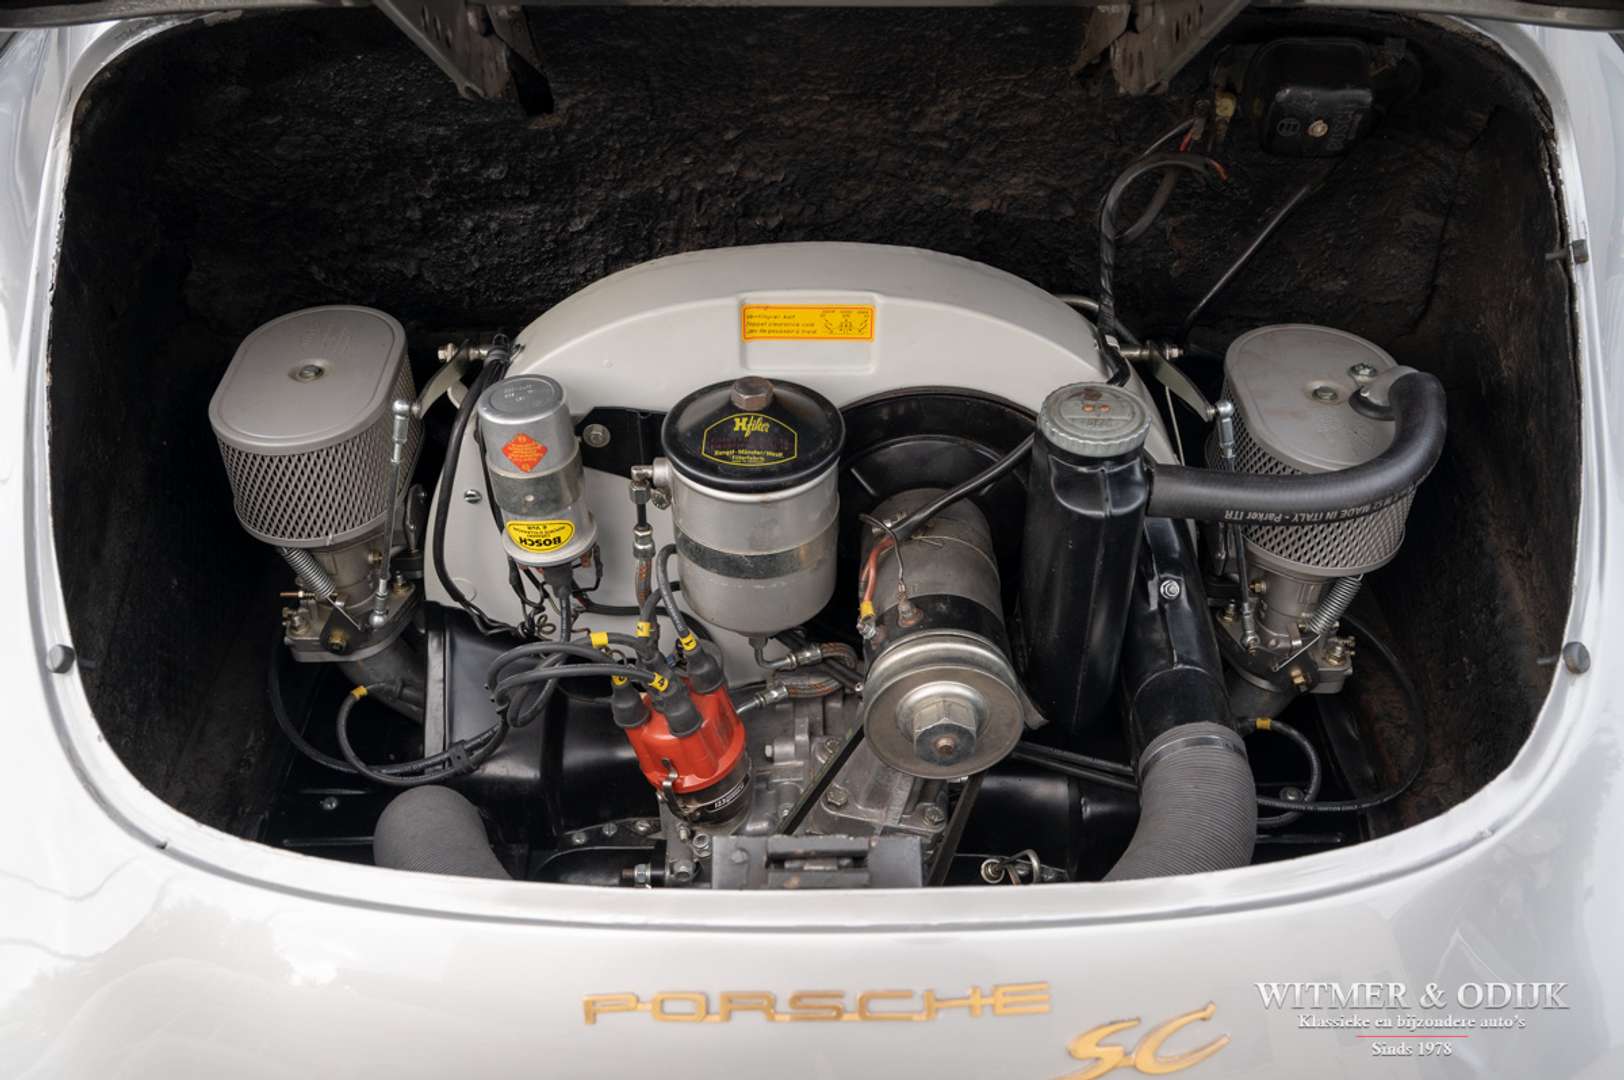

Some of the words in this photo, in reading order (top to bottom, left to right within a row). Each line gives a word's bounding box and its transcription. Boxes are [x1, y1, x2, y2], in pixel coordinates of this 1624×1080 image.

[1224, 510, 1246, 520] ITR
[1324, 511, 1339, 520] IN
[1340, 504, 1371, 518] MADE
[1246, 511, 1283, 523] Parker
[1292, 512, 1324, 522] ITALY
[519, 536, 562, 547] BOSCH
[583, 981, 1051, 1026] PORSCHE
[1052, 1000, 1232, 1080] SC
